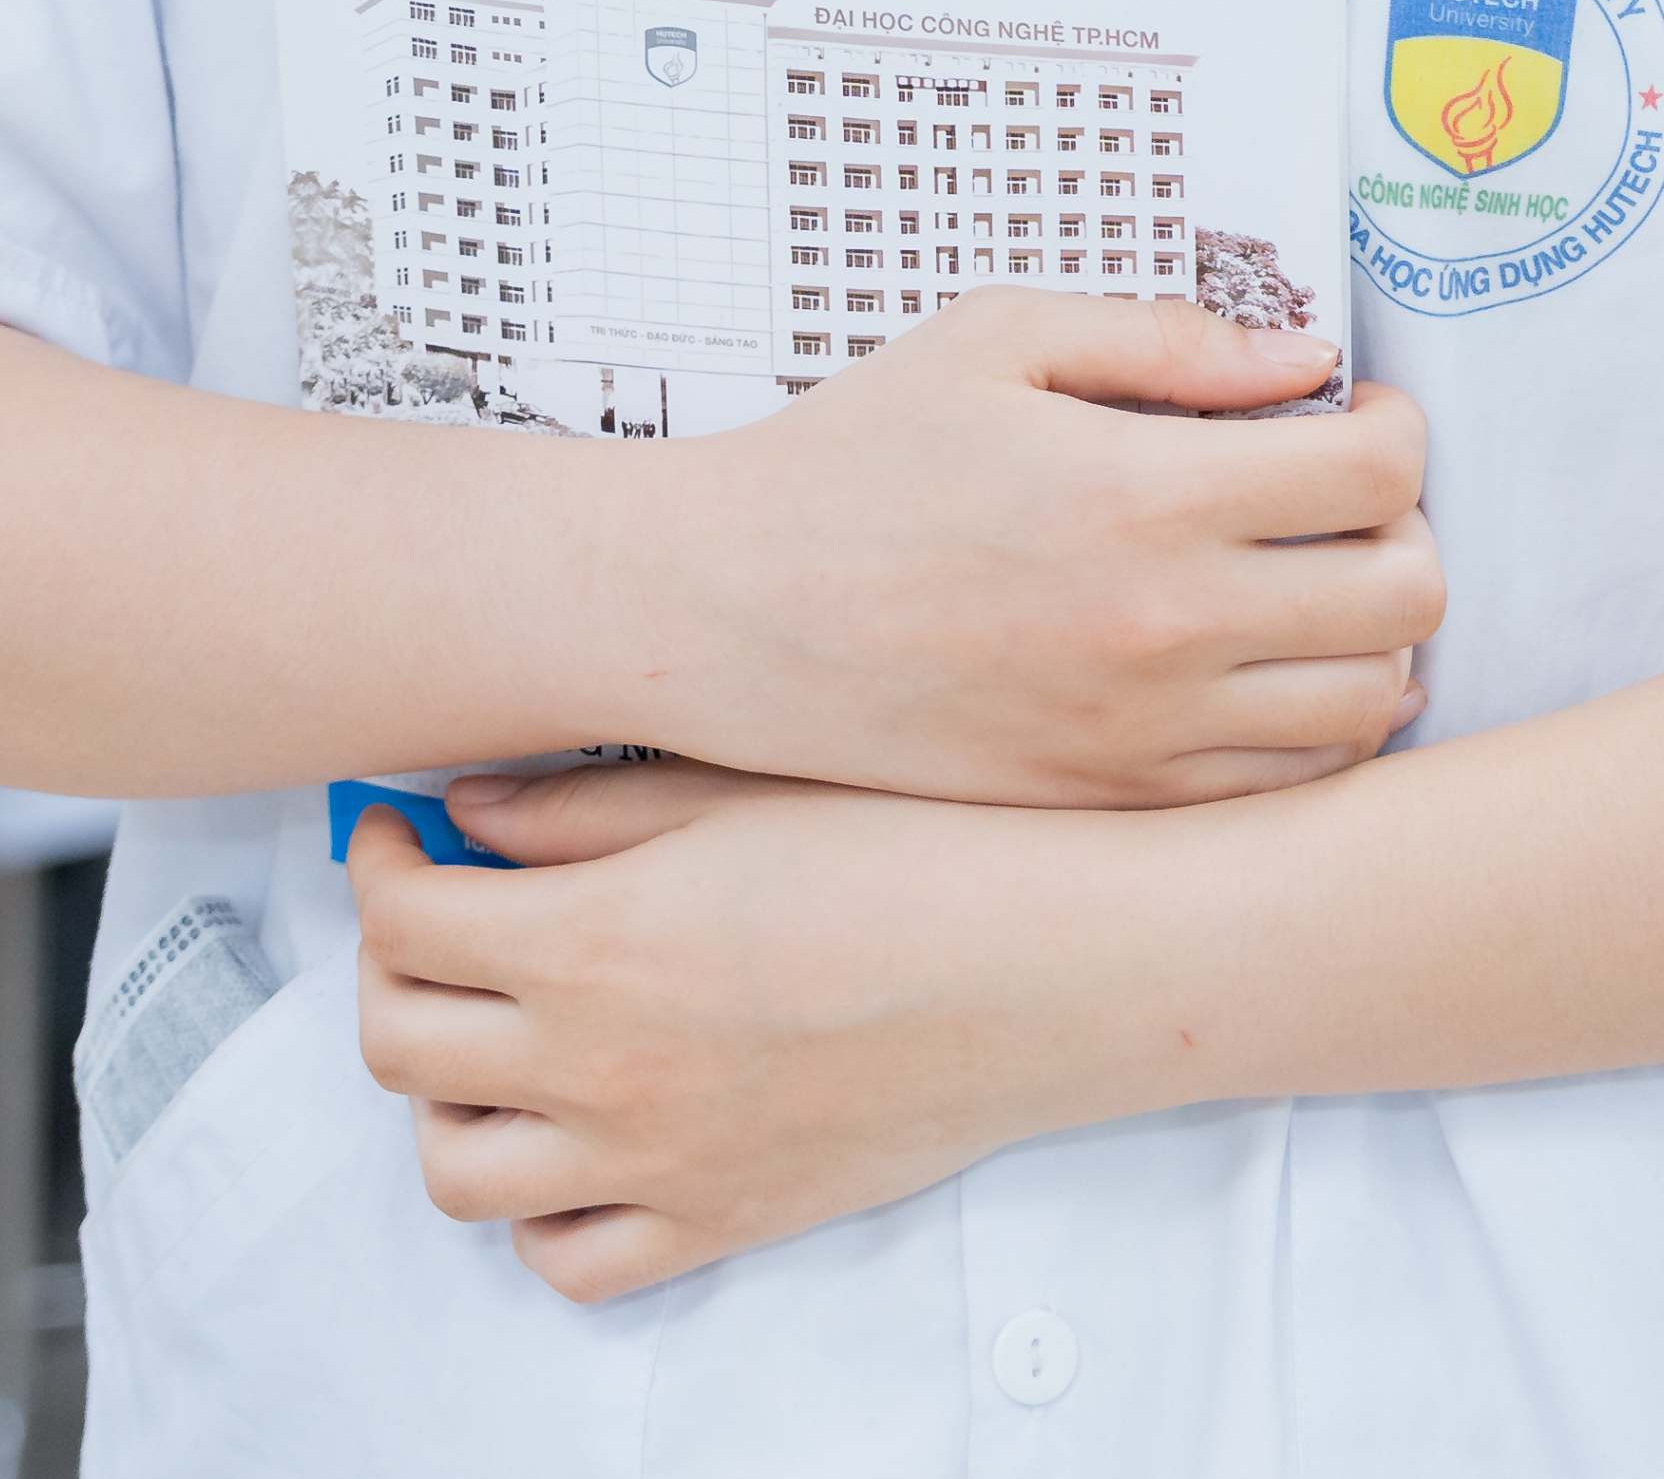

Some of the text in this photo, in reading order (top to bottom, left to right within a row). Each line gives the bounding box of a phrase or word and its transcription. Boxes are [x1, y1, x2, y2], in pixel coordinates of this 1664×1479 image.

[814, 6, 1159, 49] ĐẠI HỌC CÔNG NGHỆ TP.HCM
[1429, 1, 1535, 36] University
[1358, 173, 1569, 224] CÔNG NGHỆ SINH HỌC
[1370, 245, 1433, 298] HỌC
[1499, 236, 1587, 289] DỤNG
[1581, 129, 1664, 245] HUTECH
